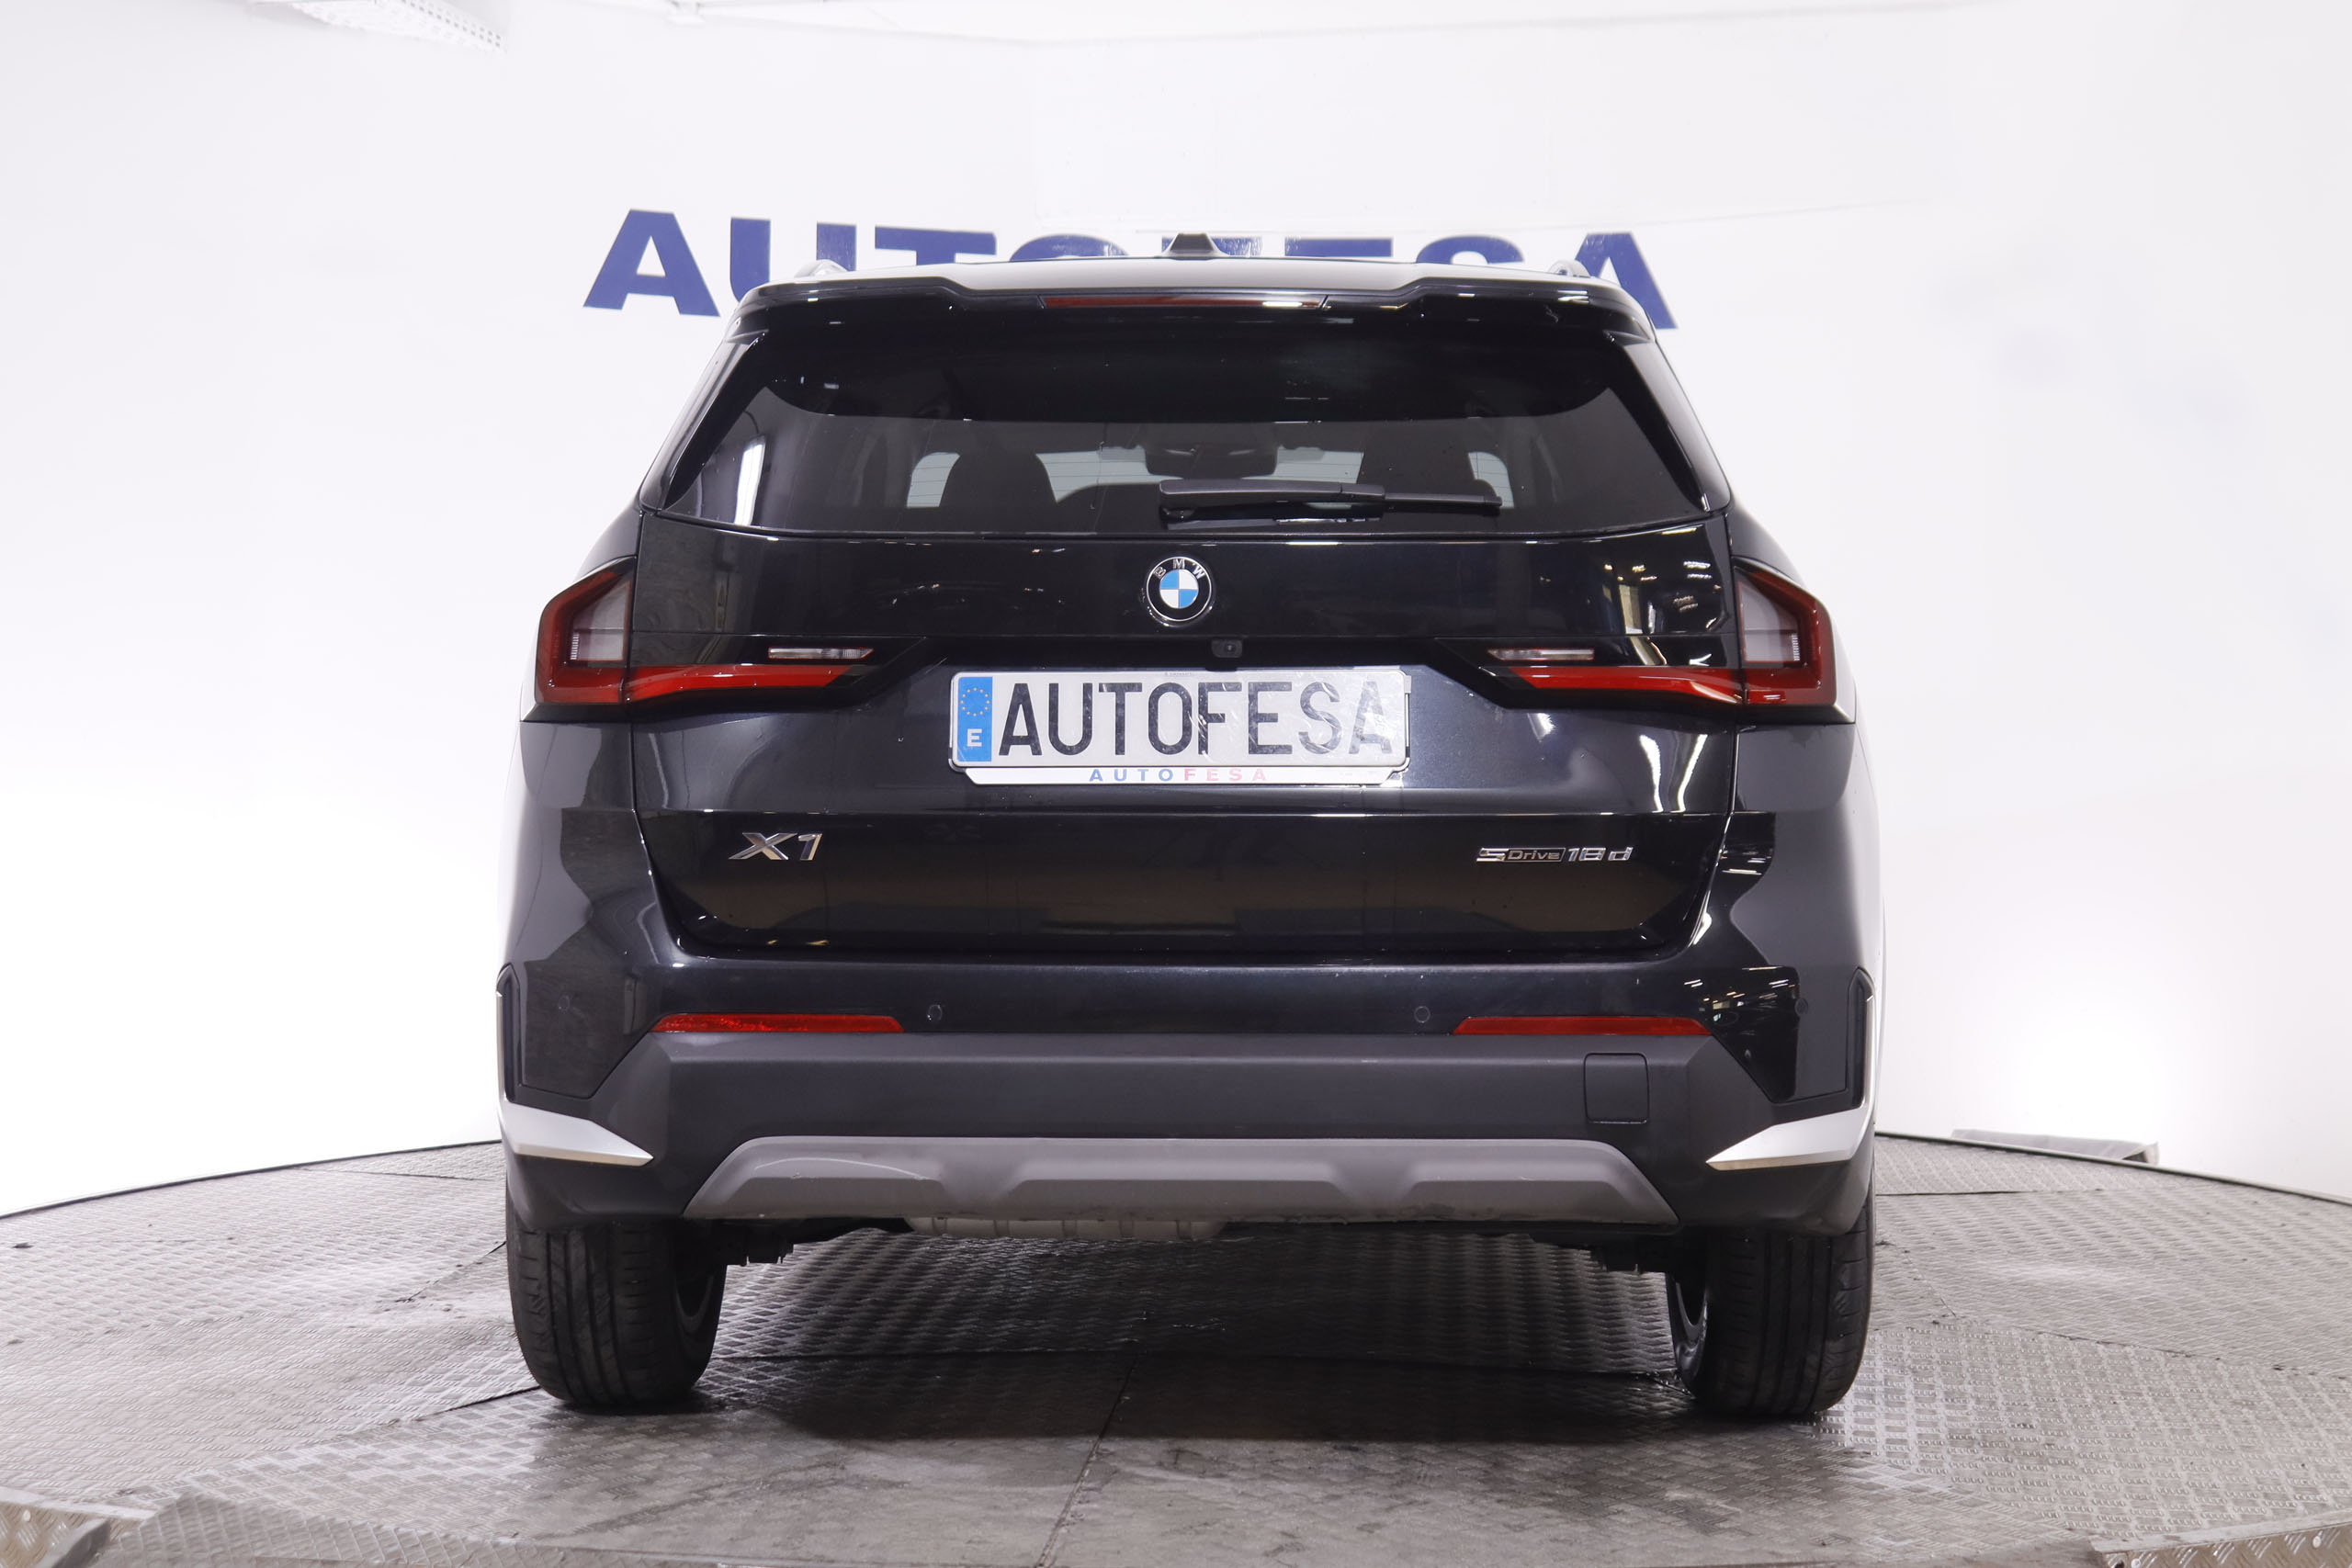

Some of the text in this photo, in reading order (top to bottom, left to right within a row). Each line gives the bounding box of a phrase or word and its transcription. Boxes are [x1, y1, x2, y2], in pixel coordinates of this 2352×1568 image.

[1152, 558, 1205, 580] BMW
[967, 682, 1393, 756] E AUTOFESA
[1089, 768, 1267, 782] AUTOFESA
[728, 832, 823, 861] X1
